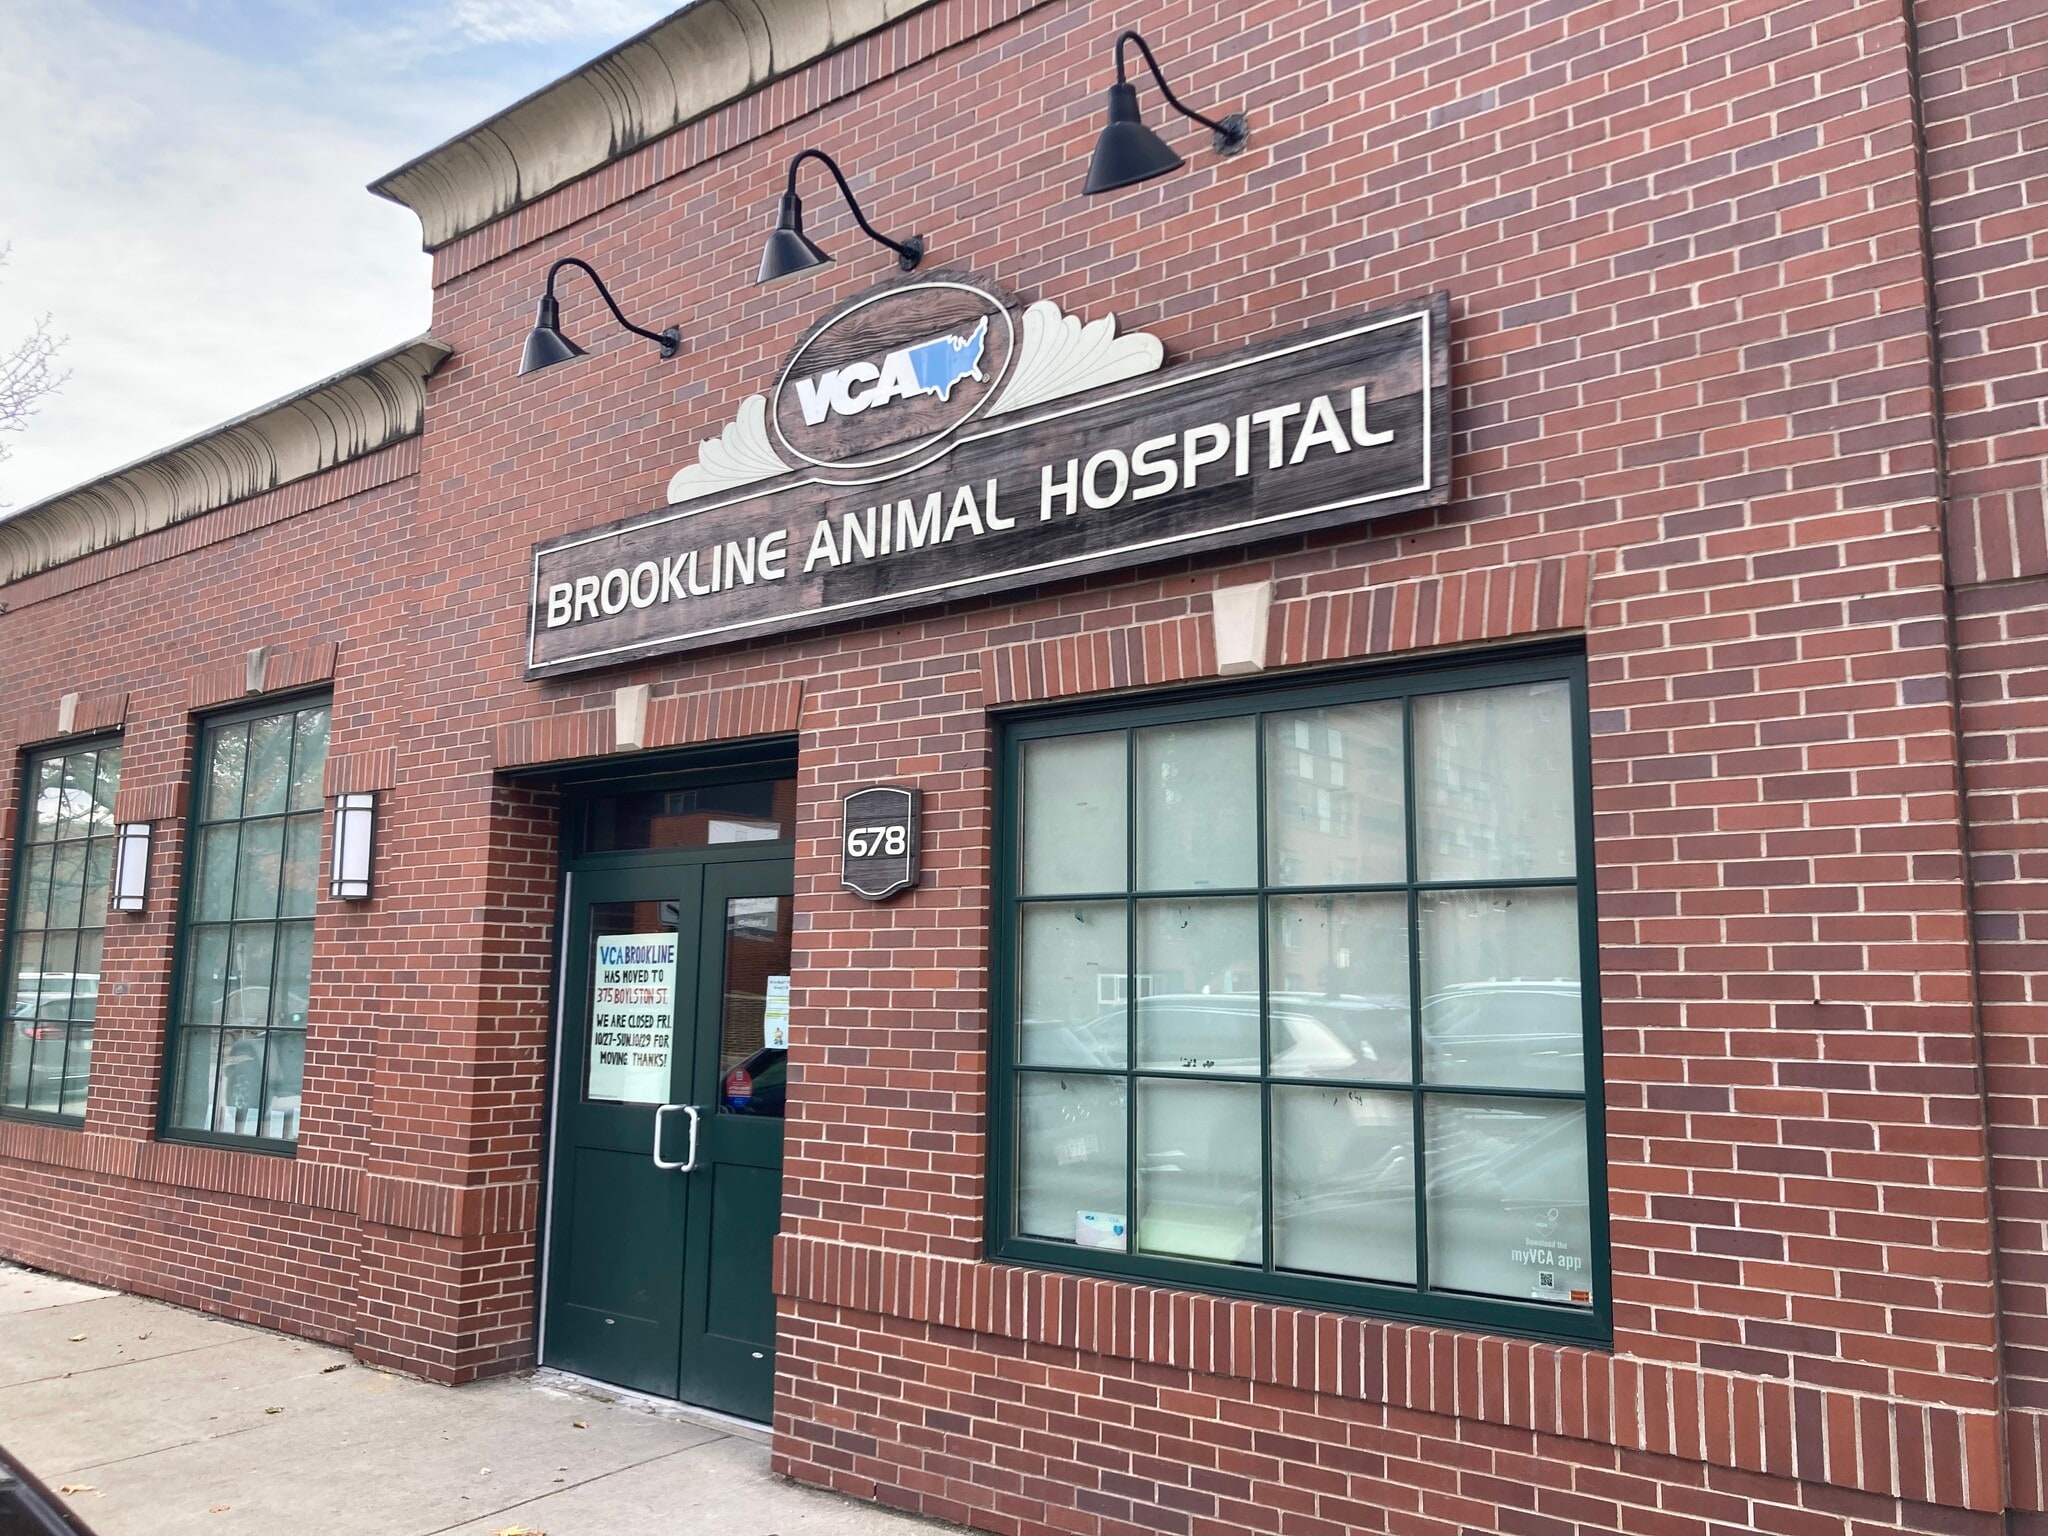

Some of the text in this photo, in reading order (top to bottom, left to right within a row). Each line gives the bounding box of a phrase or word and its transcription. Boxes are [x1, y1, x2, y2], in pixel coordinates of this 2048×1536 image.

[795, 350, 924, 426] VCA
[546, 385, 1395, 628] BROOKLINE ANIMAL HOSPITAL
[847, 825, 906, 857] 678
[600, 945, 674, 965] VCA BROOKLINE
[604, 969, 664, 983] HAS MOVED TO
[597, 987, 613, 1003] 375
[614, 987, 654, 1004] BOYLSTON
[597, 1014, 609, 1027] WE
[611, 1014, 626, 1028] ARE
[628, 1014, 654, 1028] CLOSED
[653, 1034, 669, 1048] FOR
[633, 1052, 667, 1067] THANKS!
[1511, 1248, 1582, 1271] myVCA app
